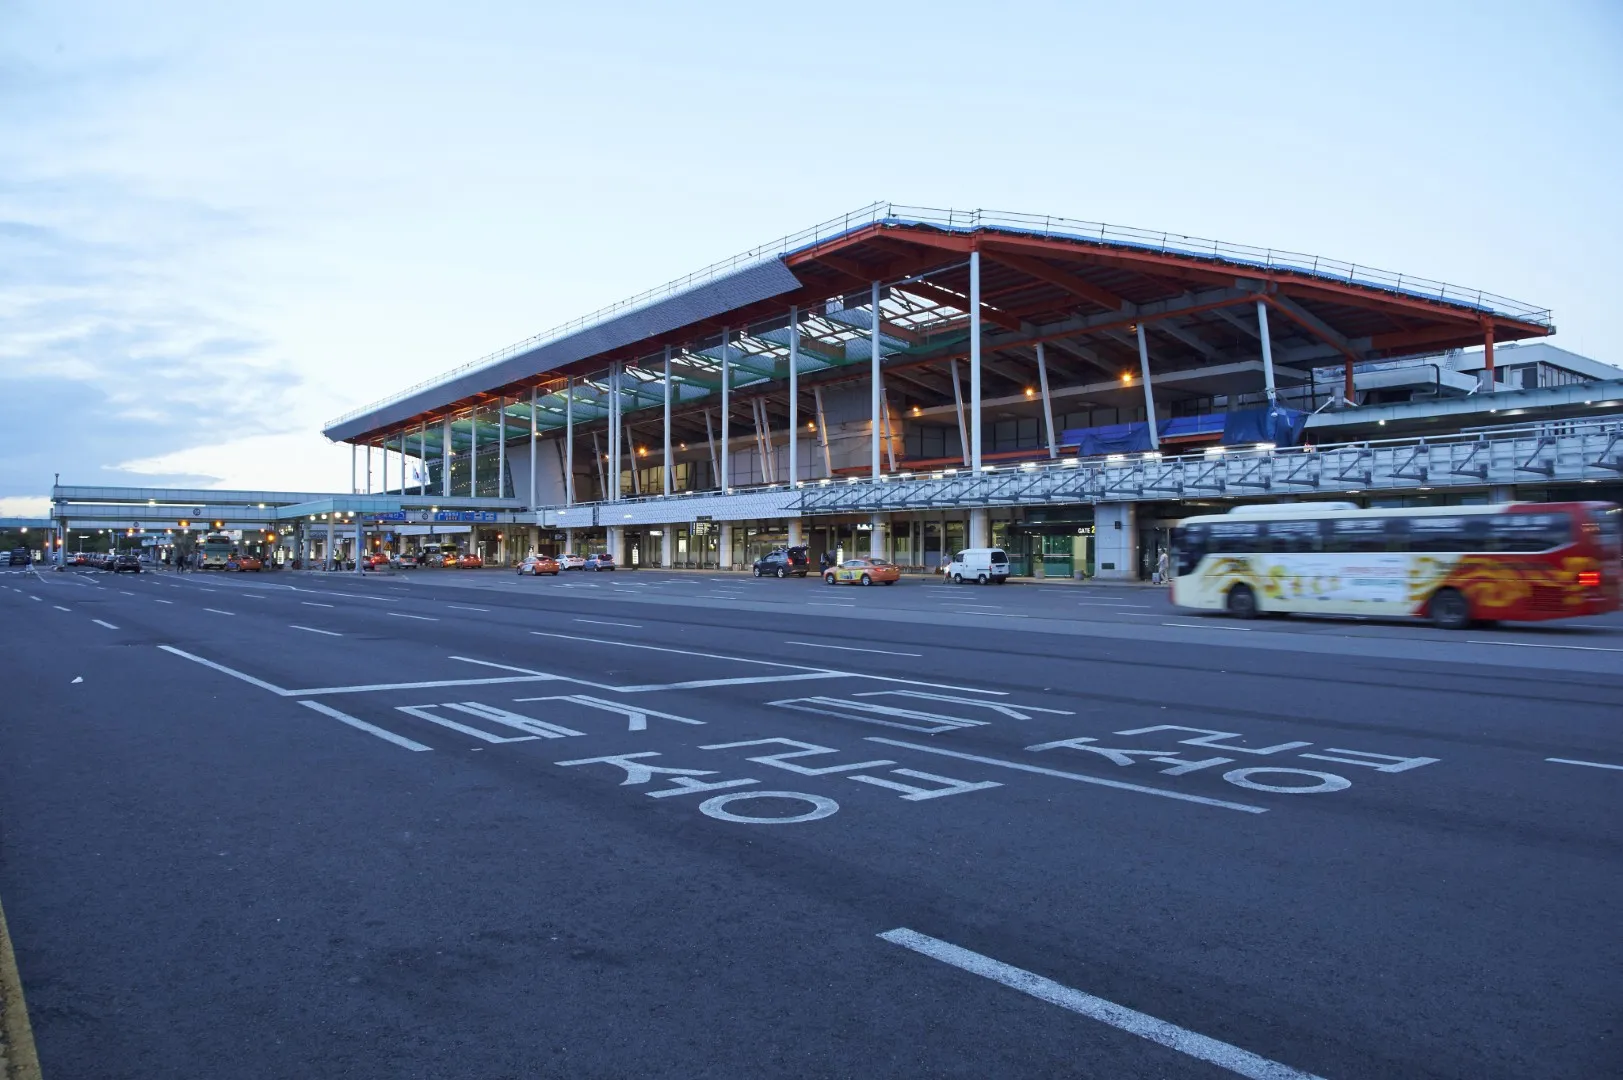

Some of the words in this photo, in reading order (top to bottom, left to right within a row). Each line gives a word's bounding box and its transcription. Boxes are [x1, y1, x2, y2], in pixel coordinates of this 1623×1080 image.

[395, 695, 707, 743] 대기
[766, 690, 1076, 735] 대기
[554, 737, 1005, 825] 종료
[1023, 724, 1441, 795] 종료
